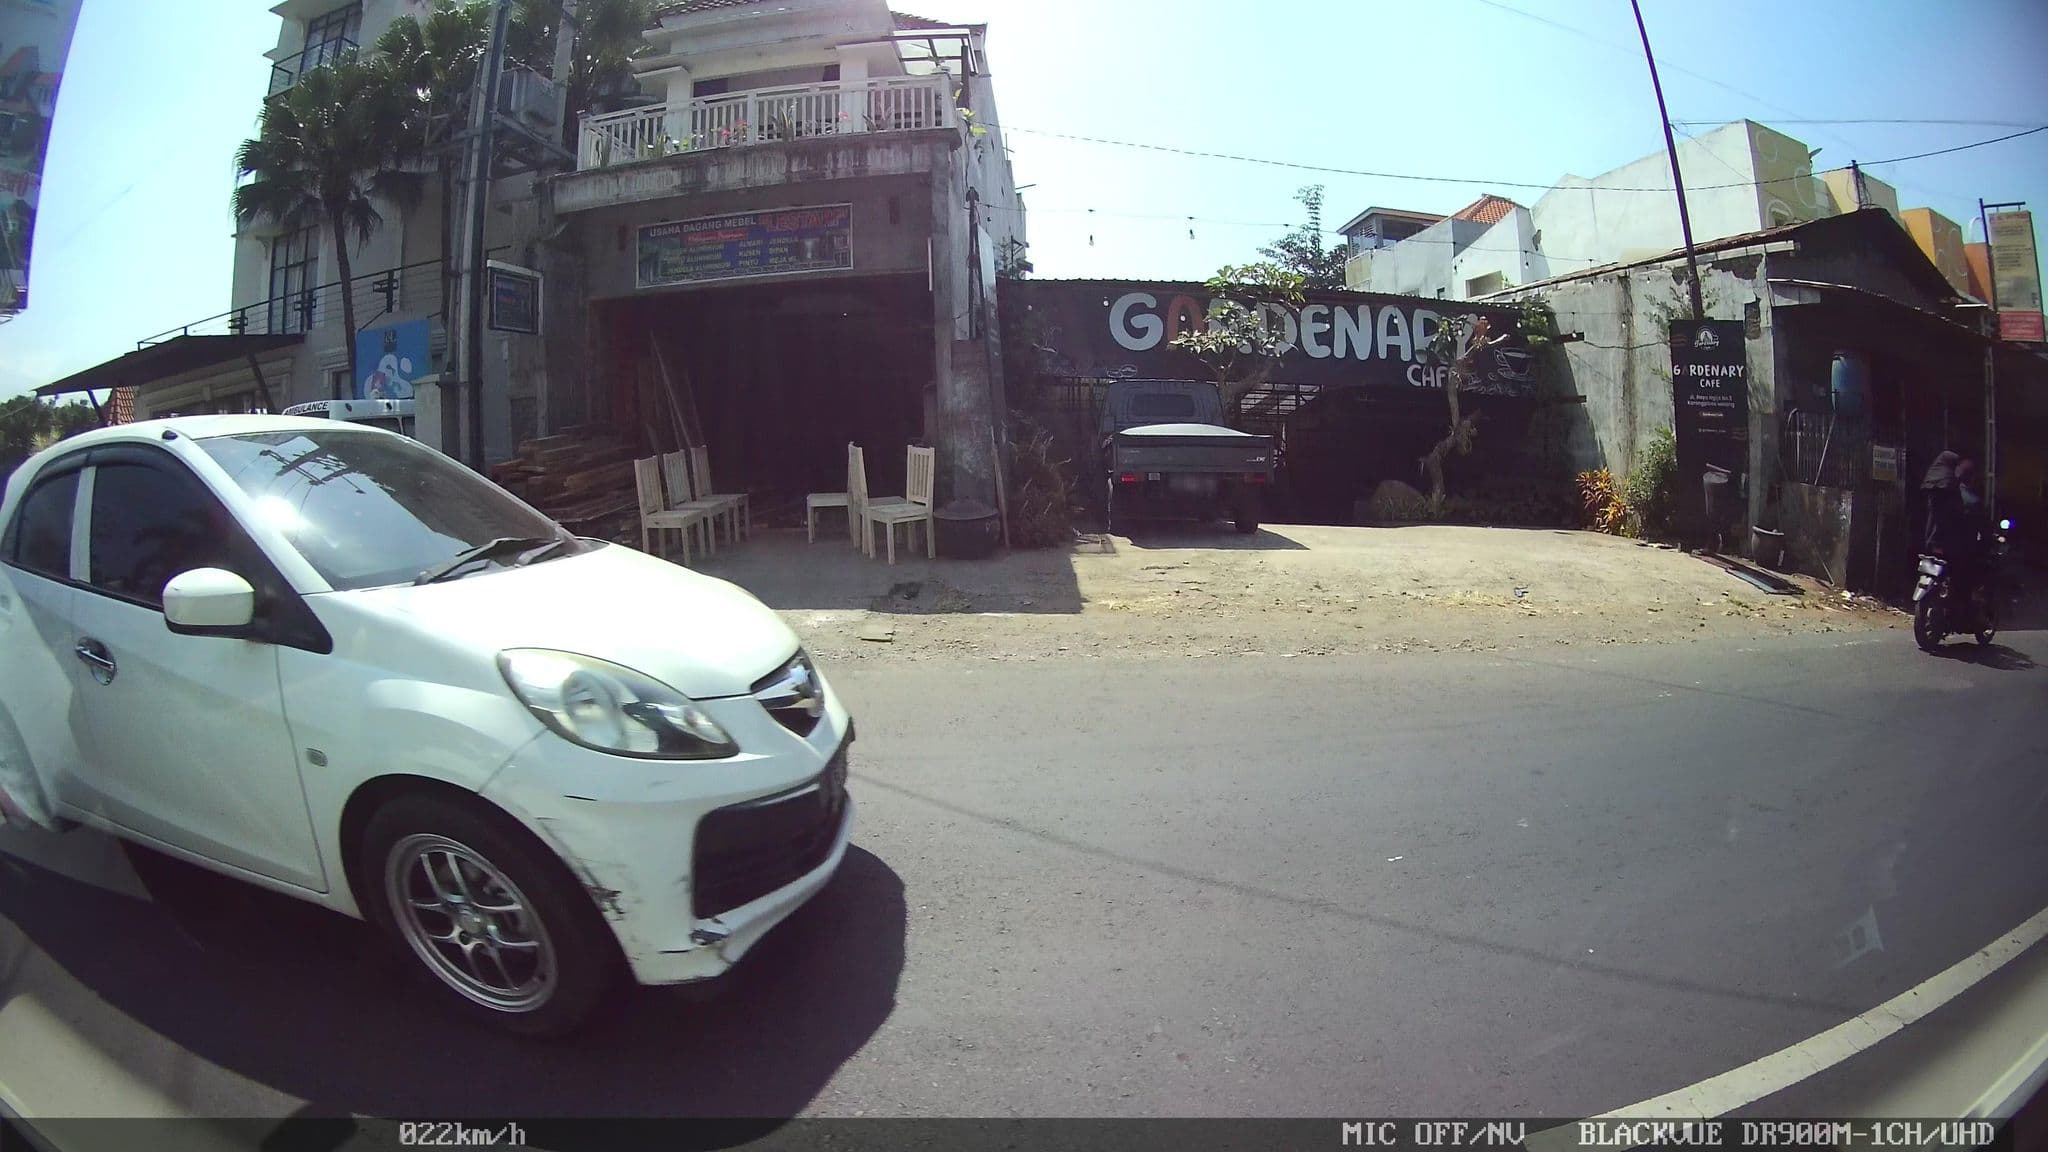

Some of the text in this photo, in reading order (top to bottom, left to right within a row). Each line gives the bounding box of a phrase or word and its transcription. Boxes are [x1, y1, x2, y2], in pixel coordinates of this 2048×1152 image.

[683, 220, 722, 233] DAGANG
[724, 215, 757, 228] MEBEL
[1406, 362, 1458, 388] CAF
[1673, 364, 1744, 378] GARDENARY
[1699, 379, 1721, 388] CAFE
[285, 401, 329, 416] AMBULANCE
